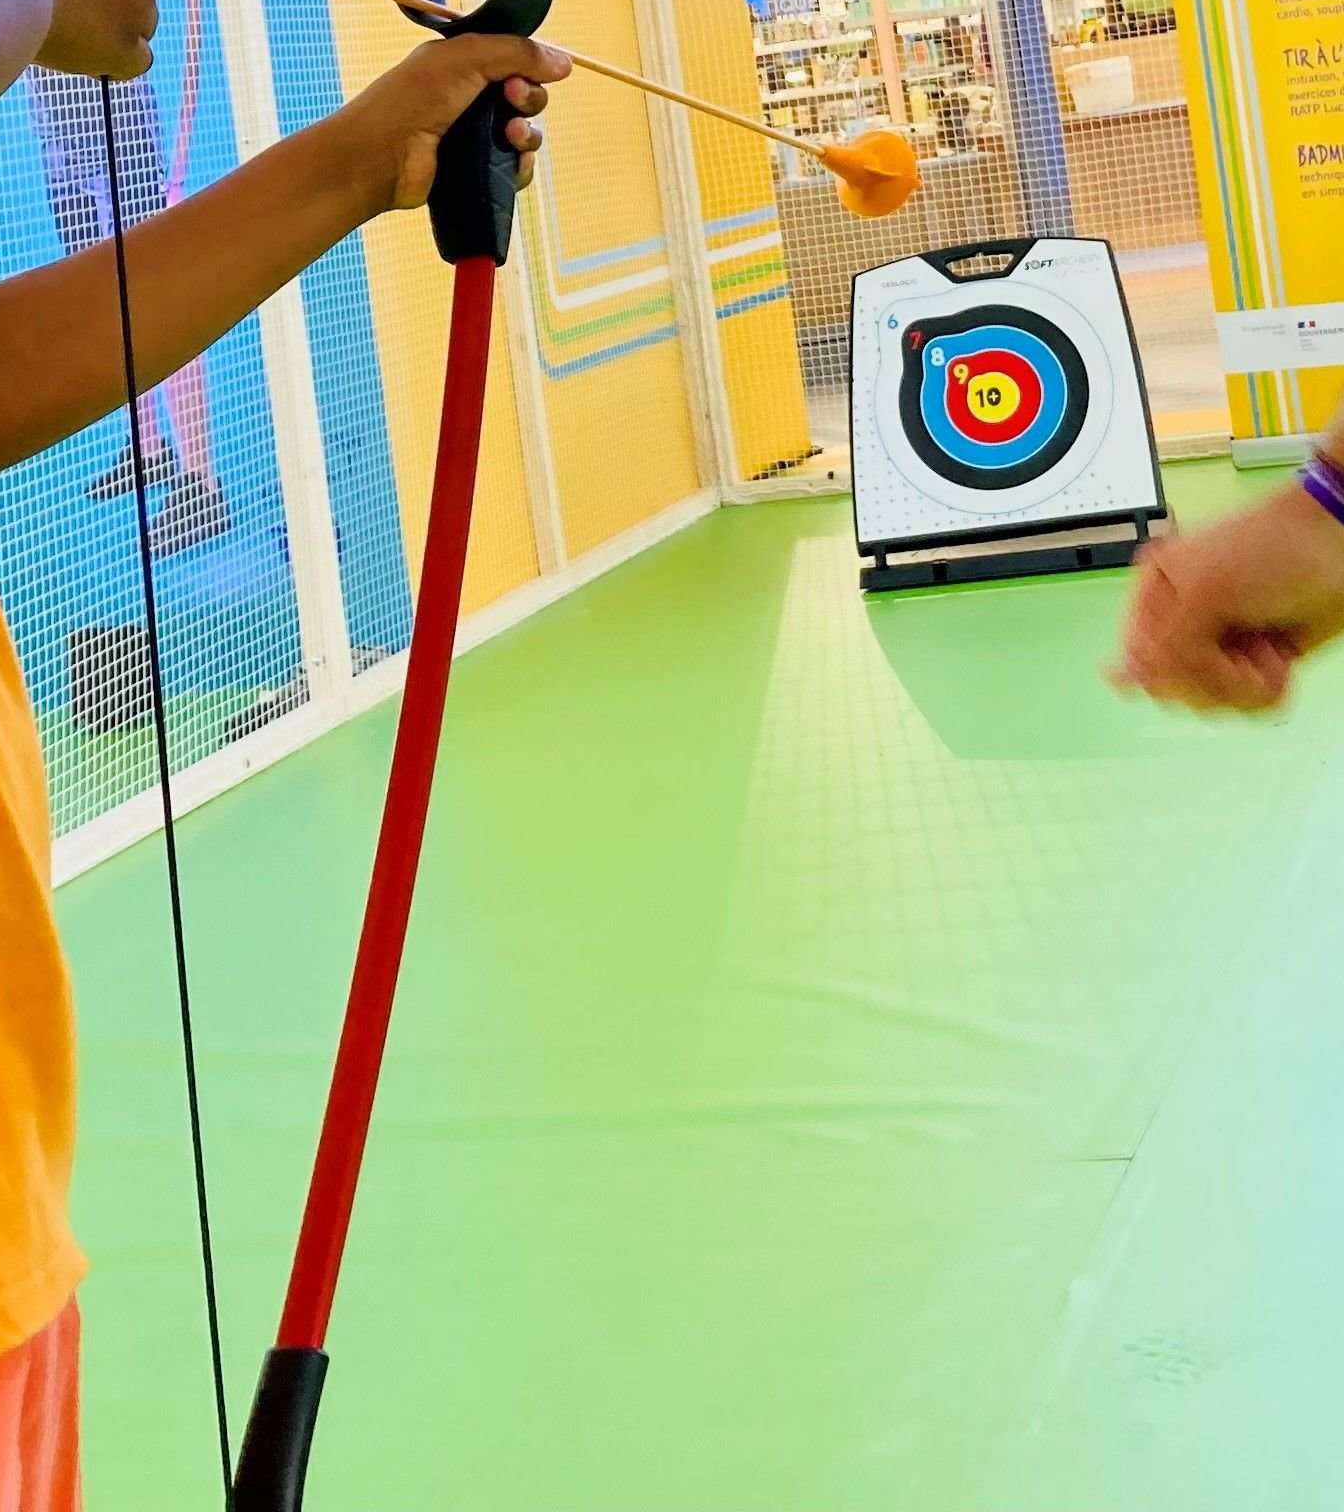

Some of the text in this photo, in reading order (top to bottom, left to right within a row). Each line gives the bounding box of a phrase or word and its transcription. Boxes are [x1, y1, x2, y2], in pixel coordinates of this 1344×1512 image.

[1276, 6, 1313, 20] cardio,
[1283, 48, 1314, 70] TIR
[1286, 70, 1338, 86] initiation,
[1288, 88, 1336, 102] exercices
[1290, 104, 1320, 117] RATP
[1302, 189, 1316, 199] en
[887, 313, 898, 329] 6
[909, 330, 922, 349] 7
[930, 347, 945, 366] 8
[953, 364, 969, 385] 9
[975, 387, 1001, 408] 10
